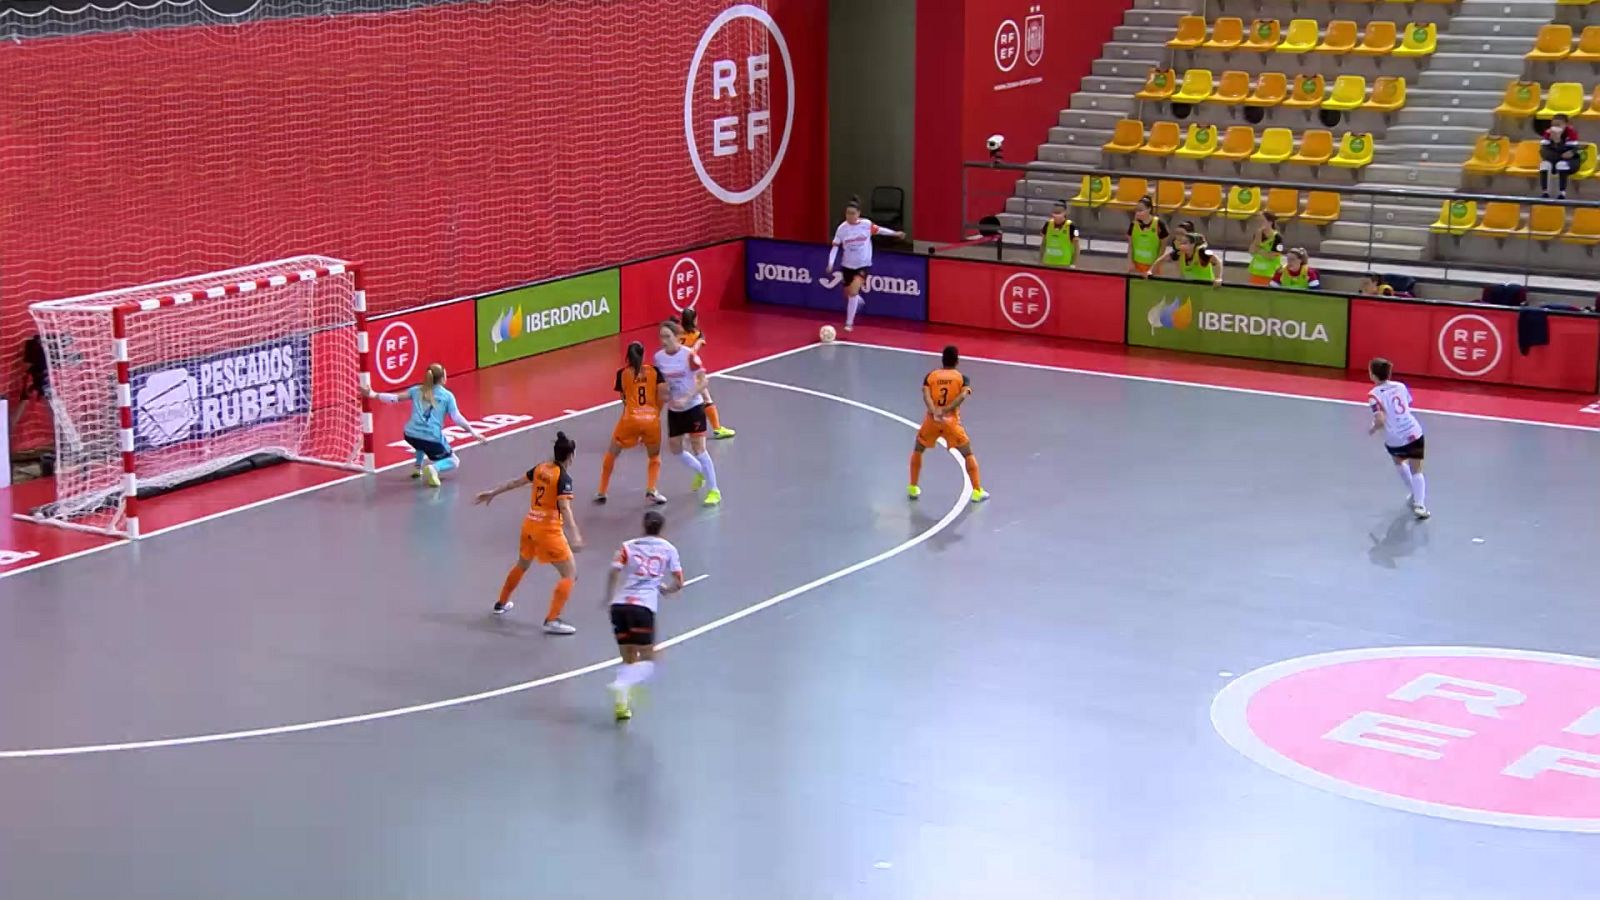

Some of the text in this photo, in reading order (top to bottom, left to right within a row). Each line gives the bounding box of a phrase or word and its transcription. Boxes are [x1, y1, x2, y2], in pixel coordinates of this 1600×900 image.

[526, 296, 610, 333] IBERDROLA
[1198, 311, 1329, 342] IBERDROLA
[200, 345, 293, 396] PESCADOS
[637, 386, 646, 406] 8
[938, 387, 948, 407] 3
[1391, 396, 1405, 415] 3
[533, 486, 545, 507] 12
